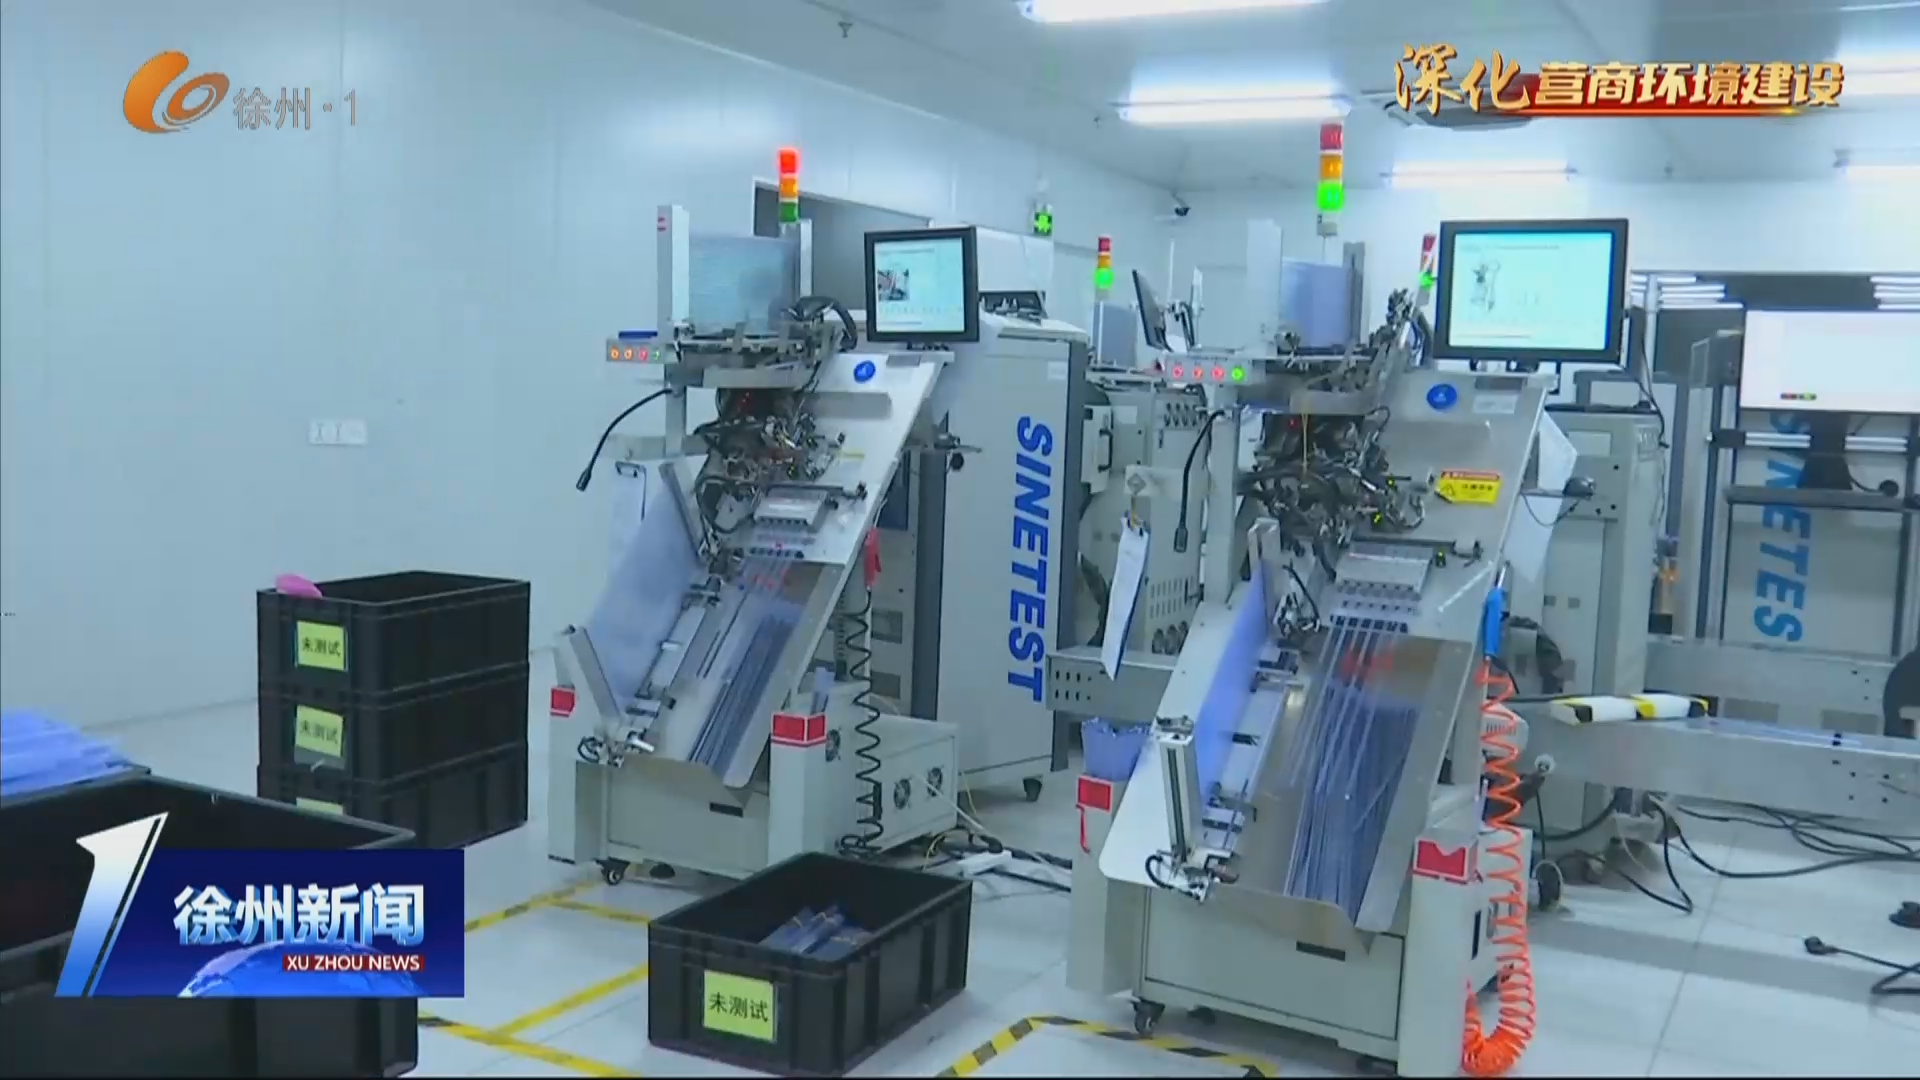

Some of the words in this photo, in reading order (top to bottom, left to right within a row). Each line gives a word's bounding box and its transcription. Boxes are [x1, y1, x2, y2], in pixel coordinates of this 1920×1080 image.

[1008, 416, 1052, 702] SINETEST
[302, 636, 341, 657] 未测试
[709, 991, 769, 1022] 未测试
